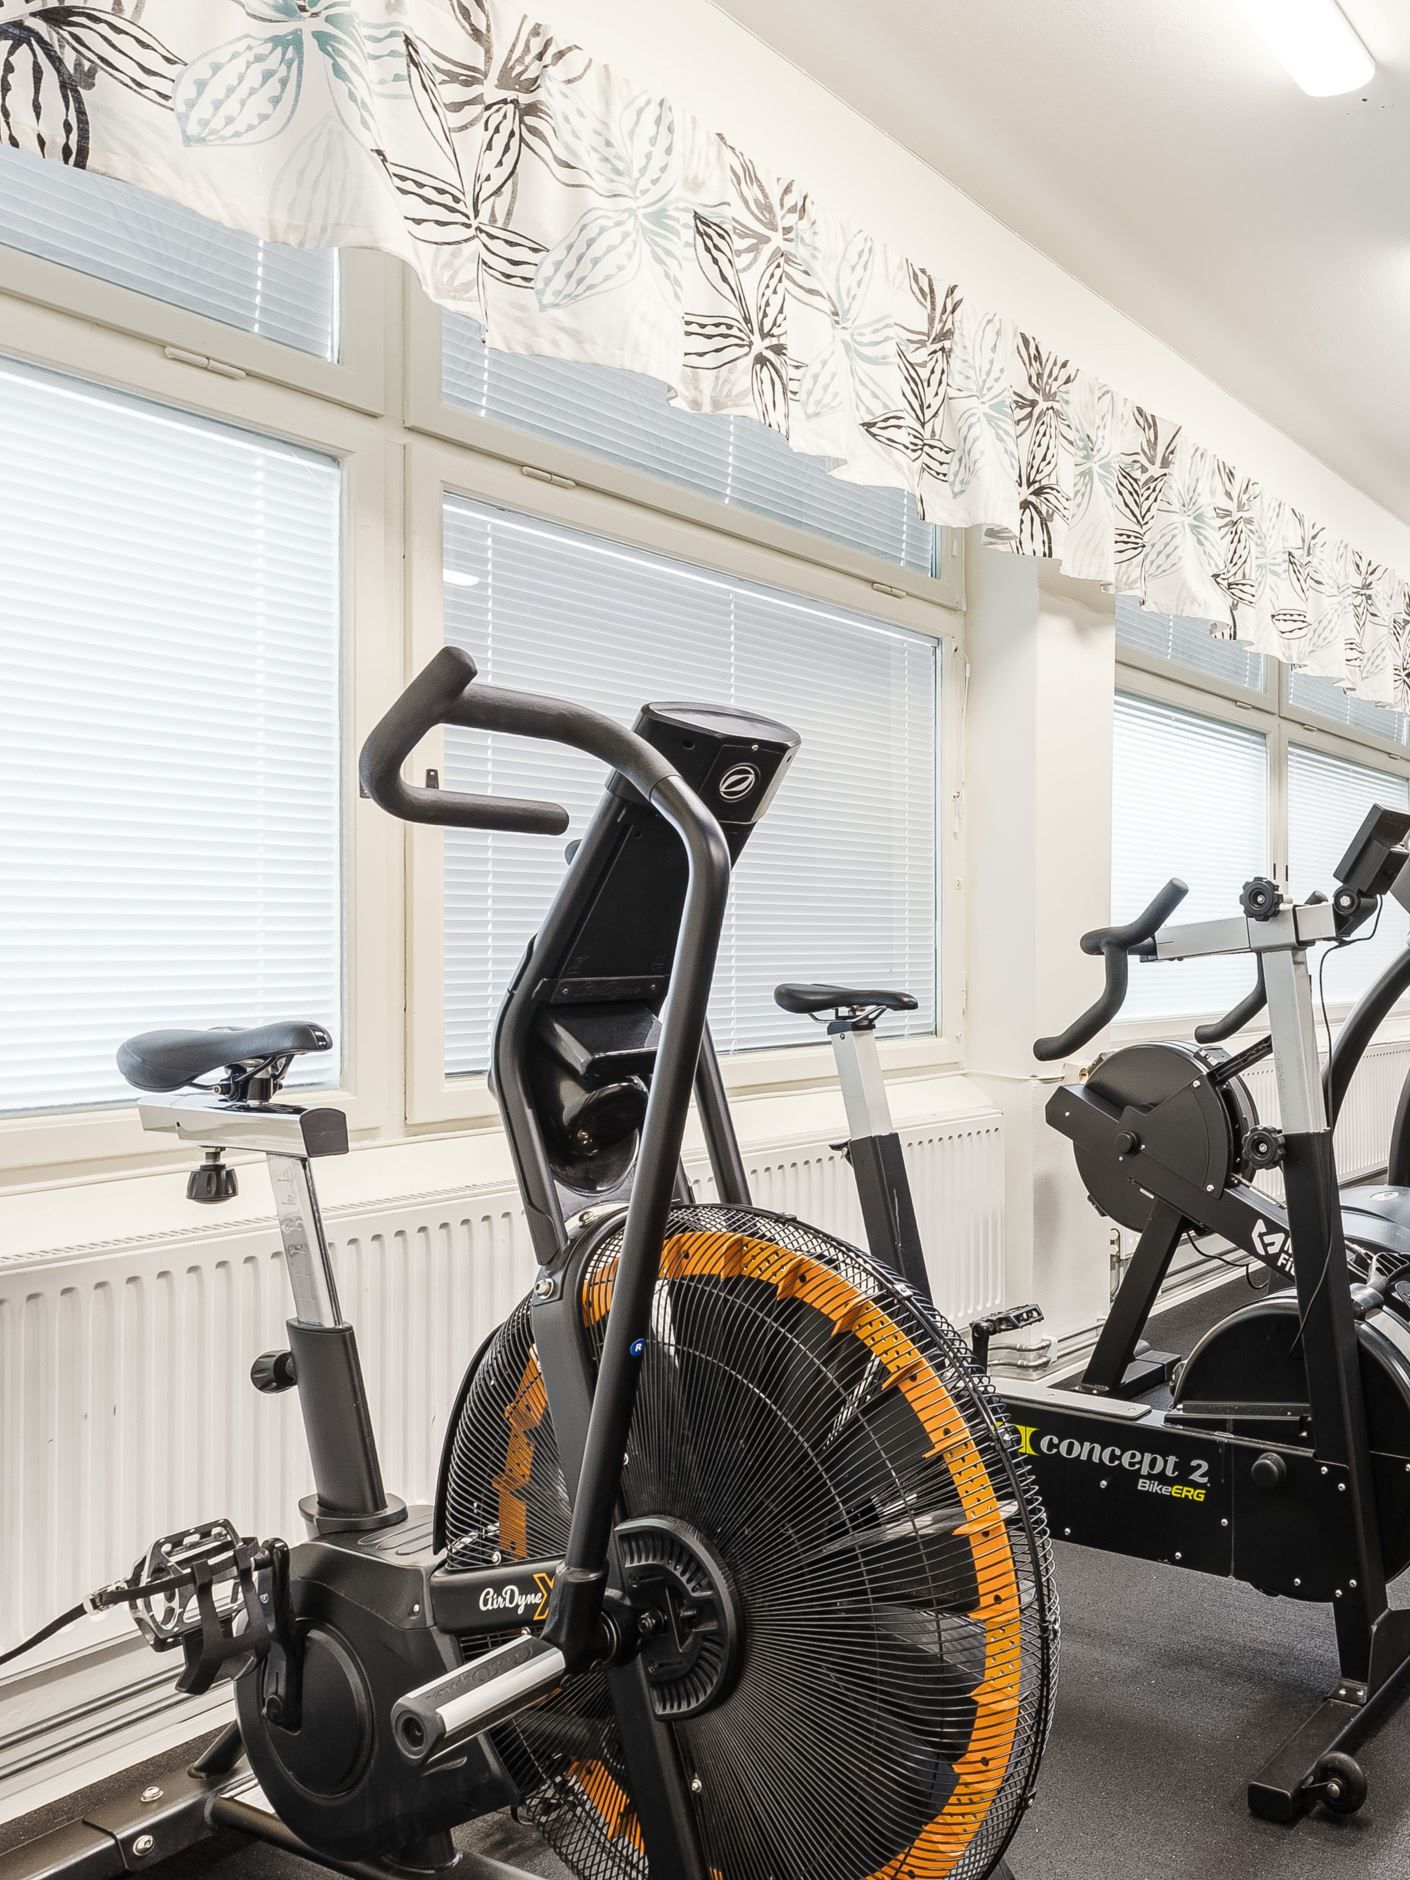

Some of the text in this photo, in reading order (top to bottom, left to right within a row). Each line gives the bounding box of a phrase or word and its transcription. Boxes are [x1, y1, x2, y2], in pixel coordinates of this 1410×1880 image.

[634, 1343, 642, 1352] R
[1040, 1434, 1210, 1484] concept 2
[1137, 1478, 1207, 1501] BikeERG
